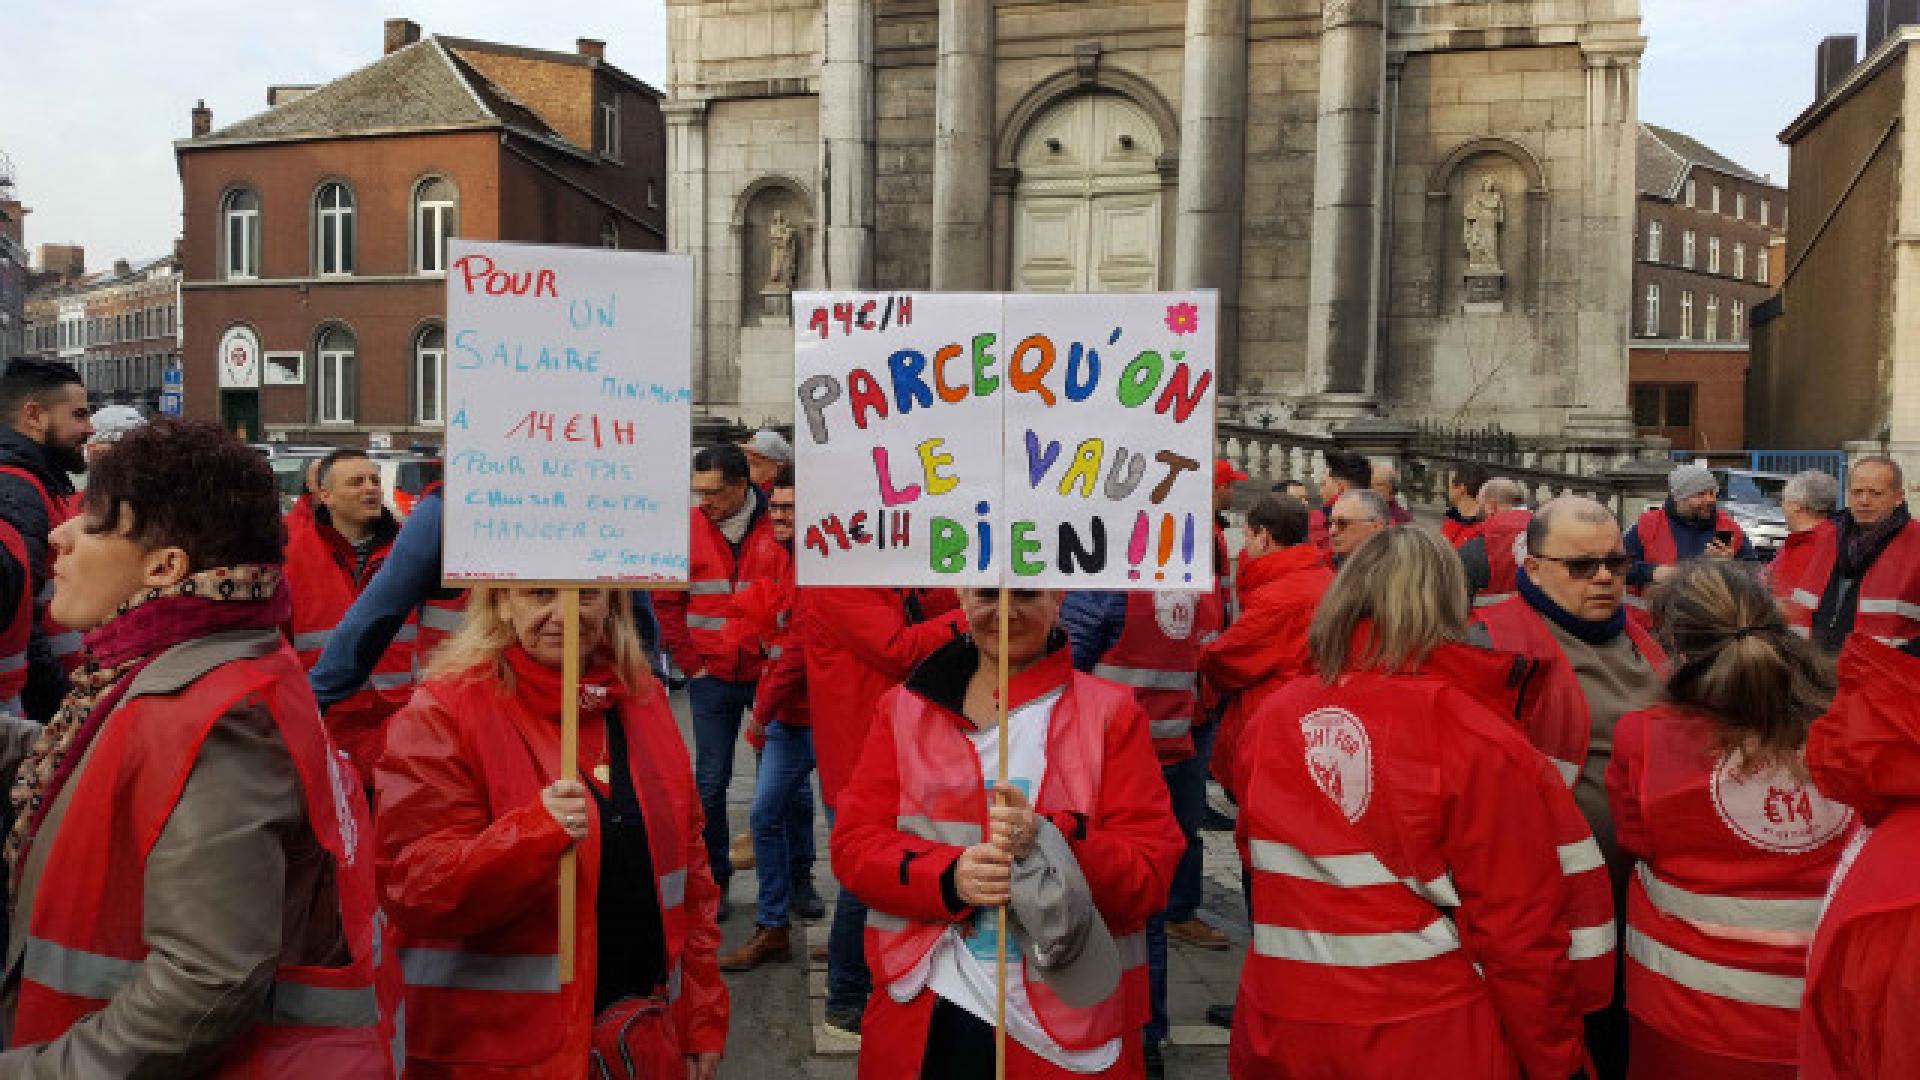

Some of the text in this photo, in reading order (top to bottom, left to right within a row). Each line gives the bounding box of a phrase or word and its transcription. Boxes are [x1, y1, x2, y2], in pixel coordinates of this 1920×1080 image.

[453, 254, 559, 298] POUR
[570, 292, 616, 330] UN
[870, 428, 1201, 508] LE VAUT
